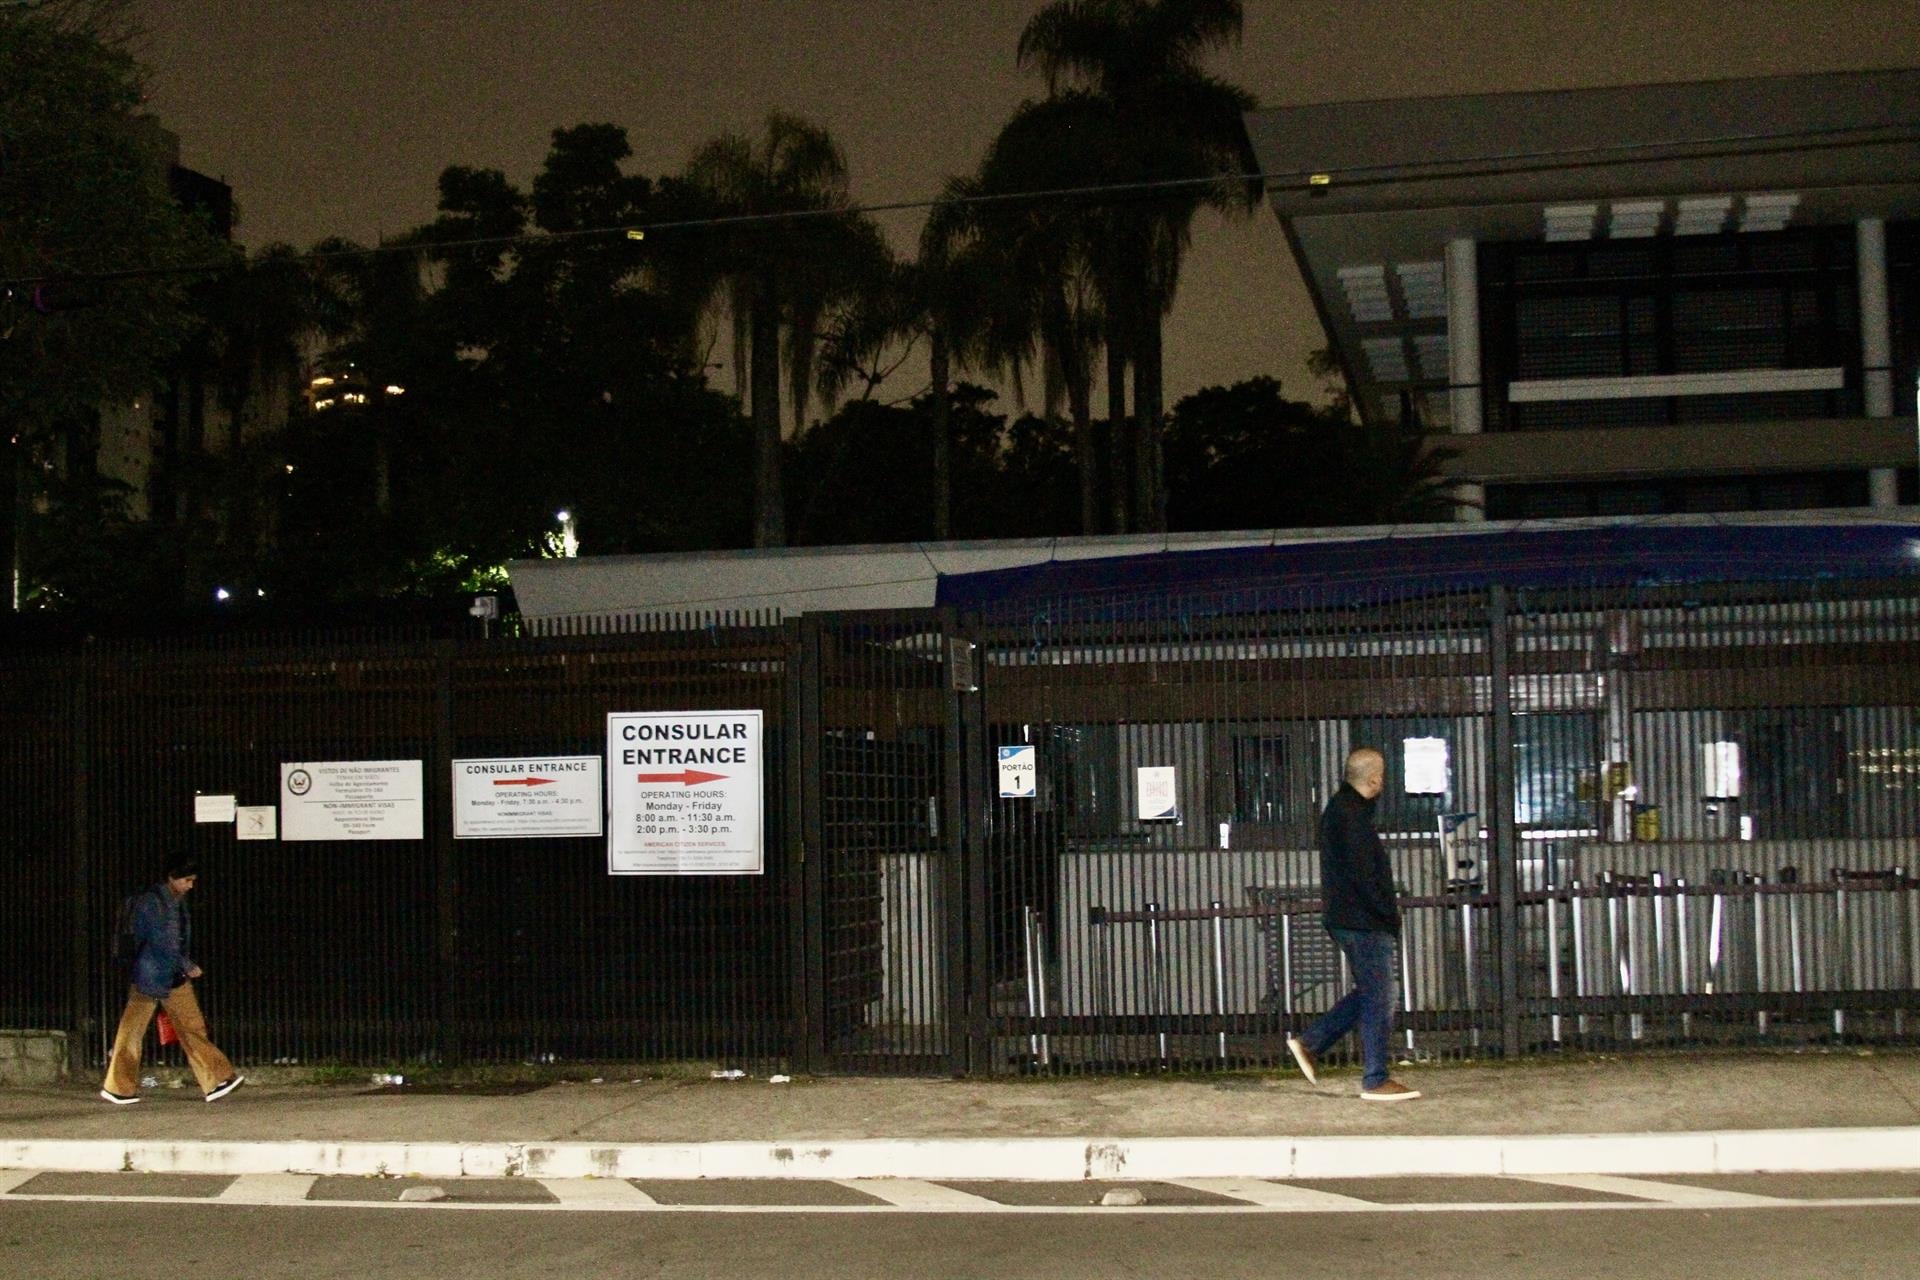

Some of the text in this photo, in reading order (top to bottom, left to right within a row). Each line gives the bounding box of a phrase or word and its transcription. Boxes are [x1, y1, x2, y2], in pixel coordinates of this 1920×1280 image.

[622, 723, 748, 741] CONSULAR
[623, 747, 746, 765] ENTRANCE
[466, 762, 588, 774] CONSULAR ENTRANCE
[1002, 762, 1033, 771] PORTÃO
[1014, 775, 1020, 789] 1
[640, 790, 727, 799] OPERATING HOURS:
[646, 802, 683, 812] Monday
[692, 801, 722, 812] Friday
[636, 813, 656, 822] 8:00
[687, 813, 712, 822] 11:30
[636, 825, 657, 834] 2:00
[659, 827, 680, 835] p.m.
[688, 825, 709, 833] 3:30
[711, 826, 732, 835] p.m.
